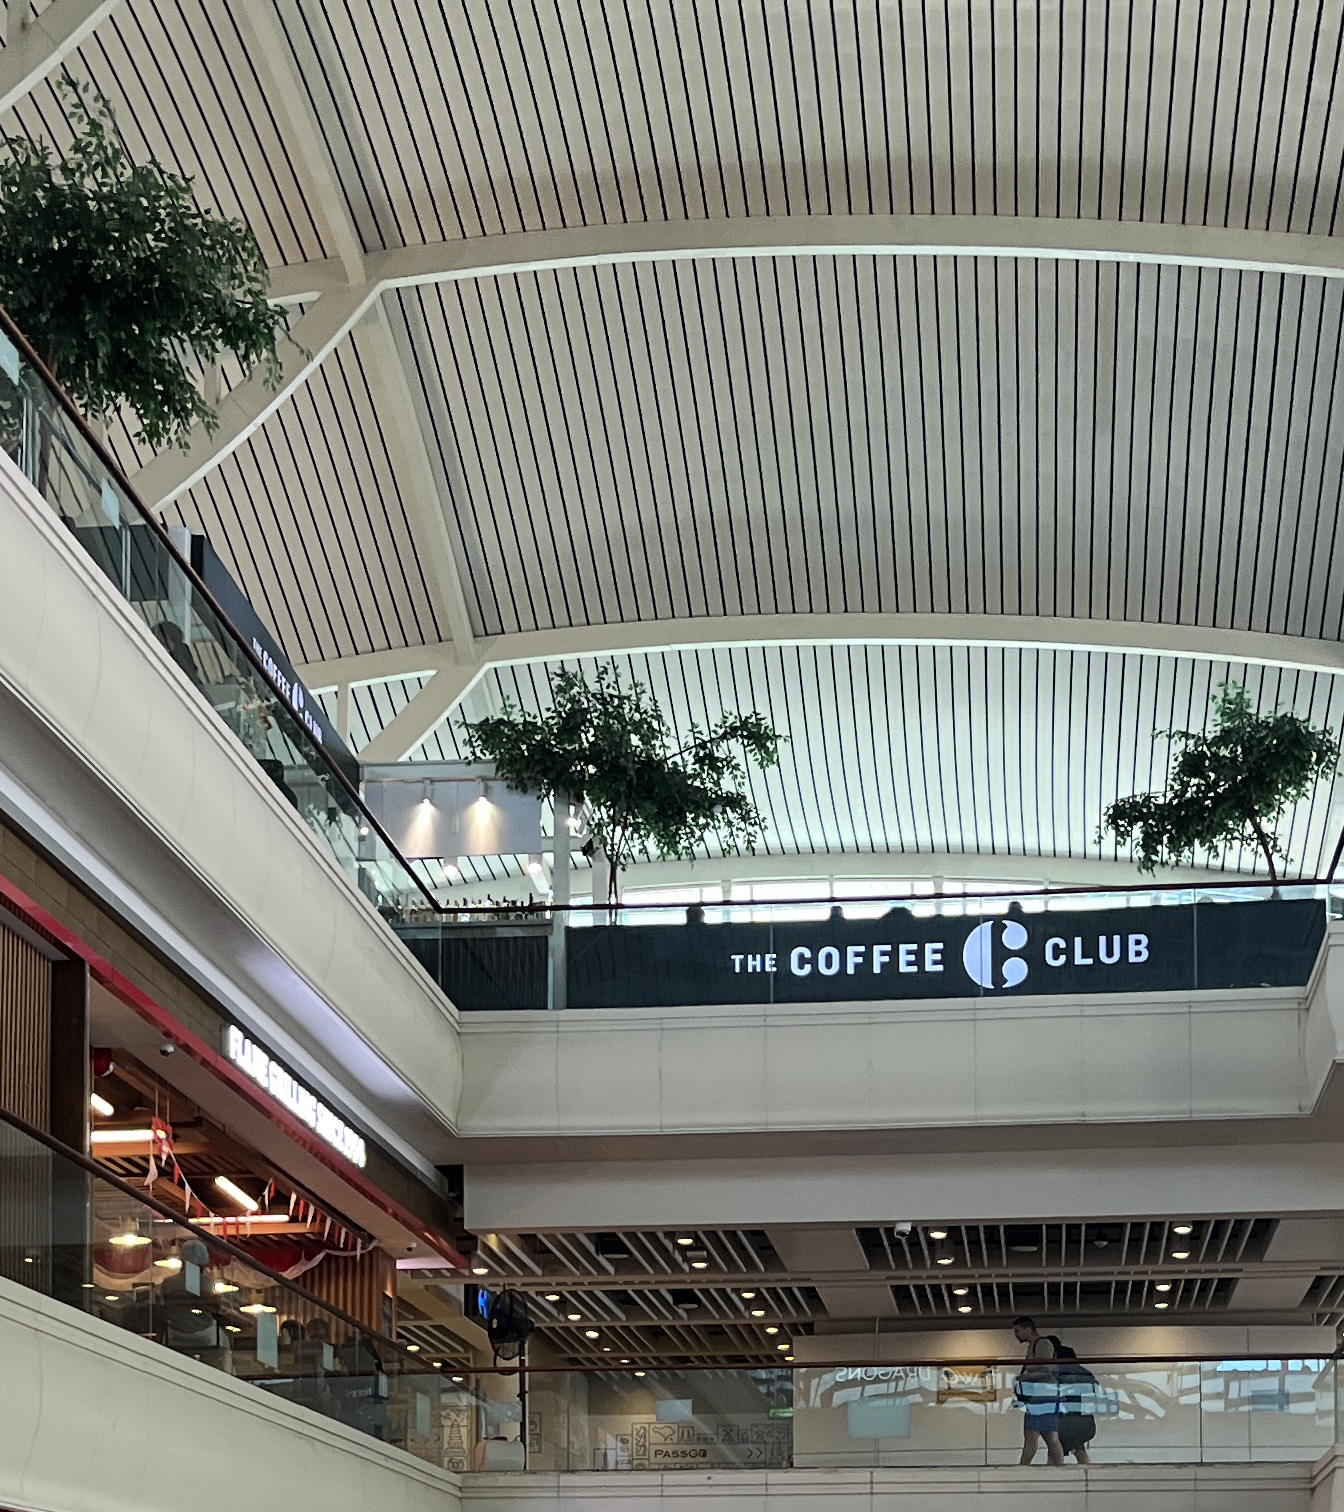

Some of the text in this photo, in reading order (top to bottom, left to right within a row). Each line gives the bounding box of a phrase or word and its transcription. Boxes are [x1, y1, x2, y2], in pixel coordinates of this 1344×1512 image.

[730, 953, 777, 973] THE
[789, 942, 945, 977] COFFEE
[1044, 933, 1149, 967] CLUB
